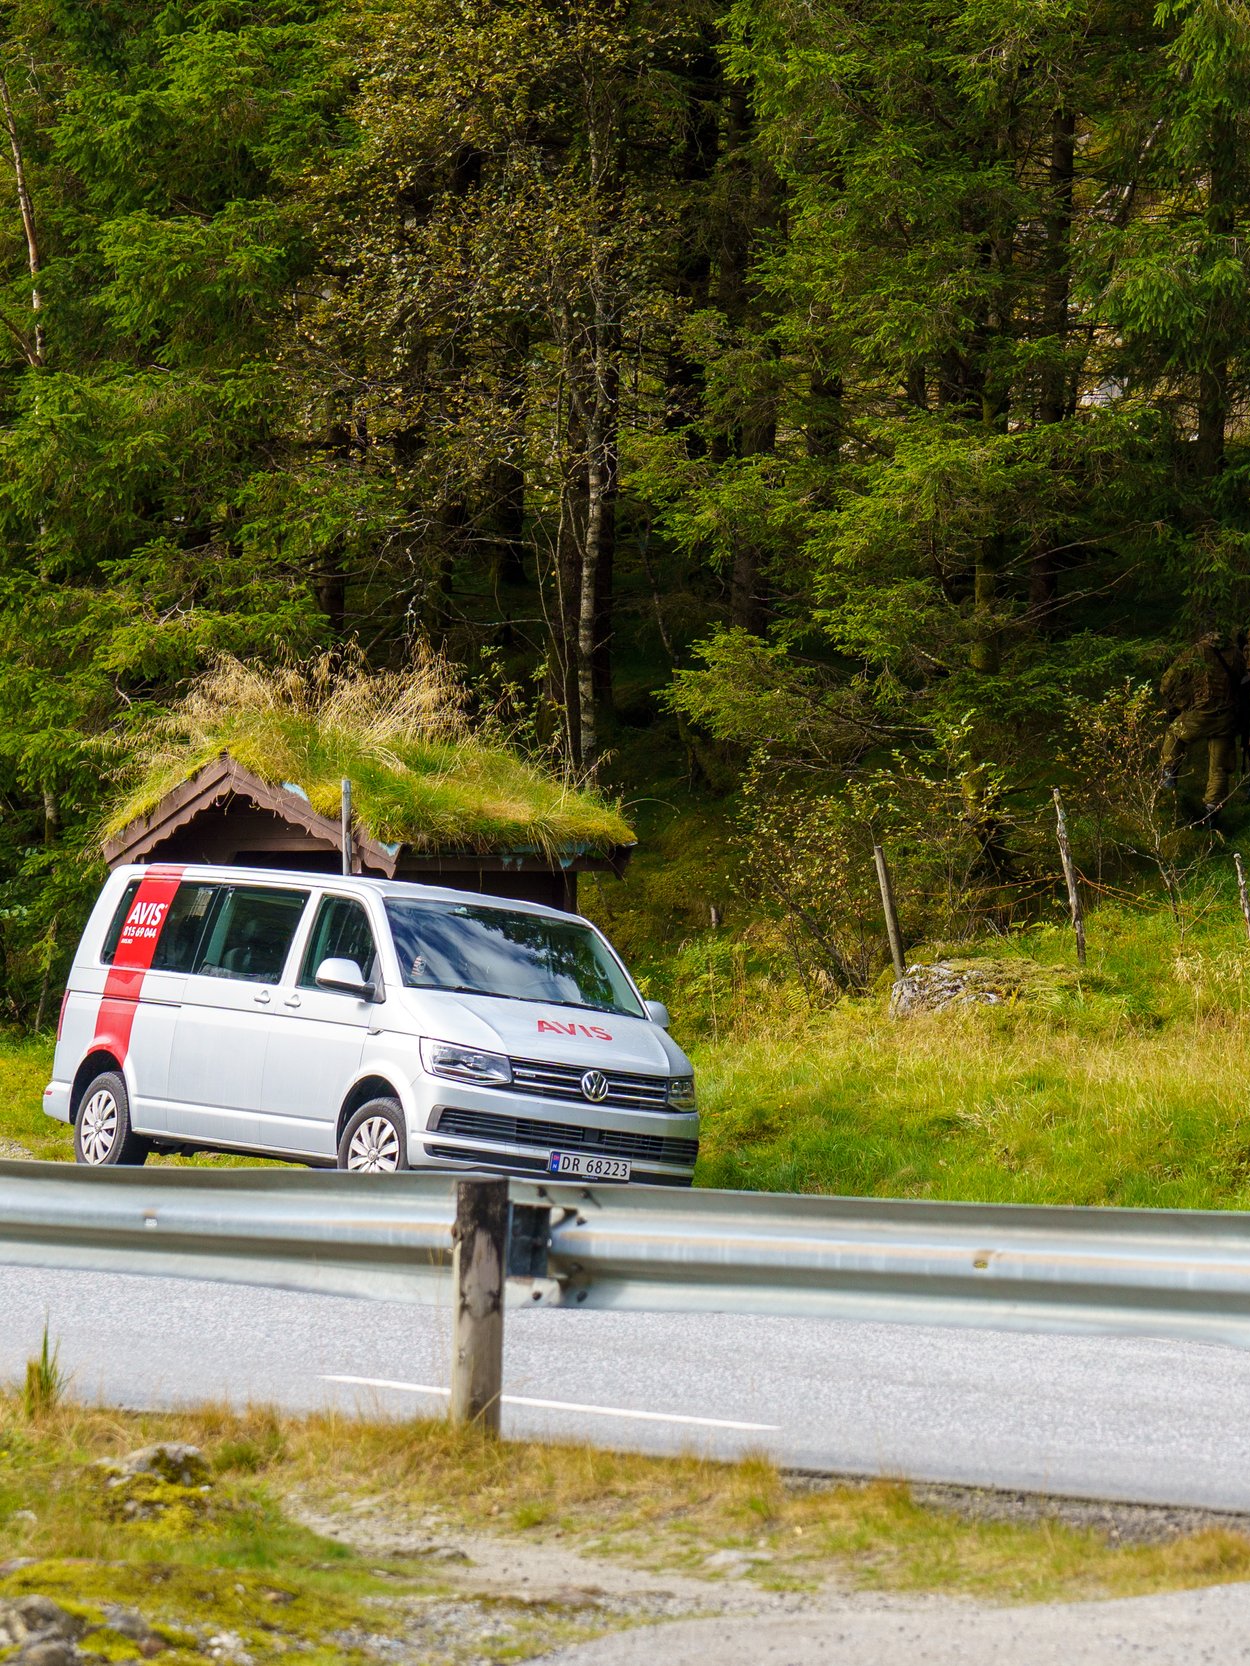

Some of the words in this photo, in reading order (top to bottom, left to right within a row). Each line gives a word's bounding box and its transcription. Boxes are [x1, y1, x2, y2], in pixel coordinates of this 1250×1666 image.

[127, 902, 165, 926] AVIS
[537, 1020, 612, 1041] AVIS
[561, 1156, 580, 1171] DR
[586, 1159, 628, 1177] 68223
